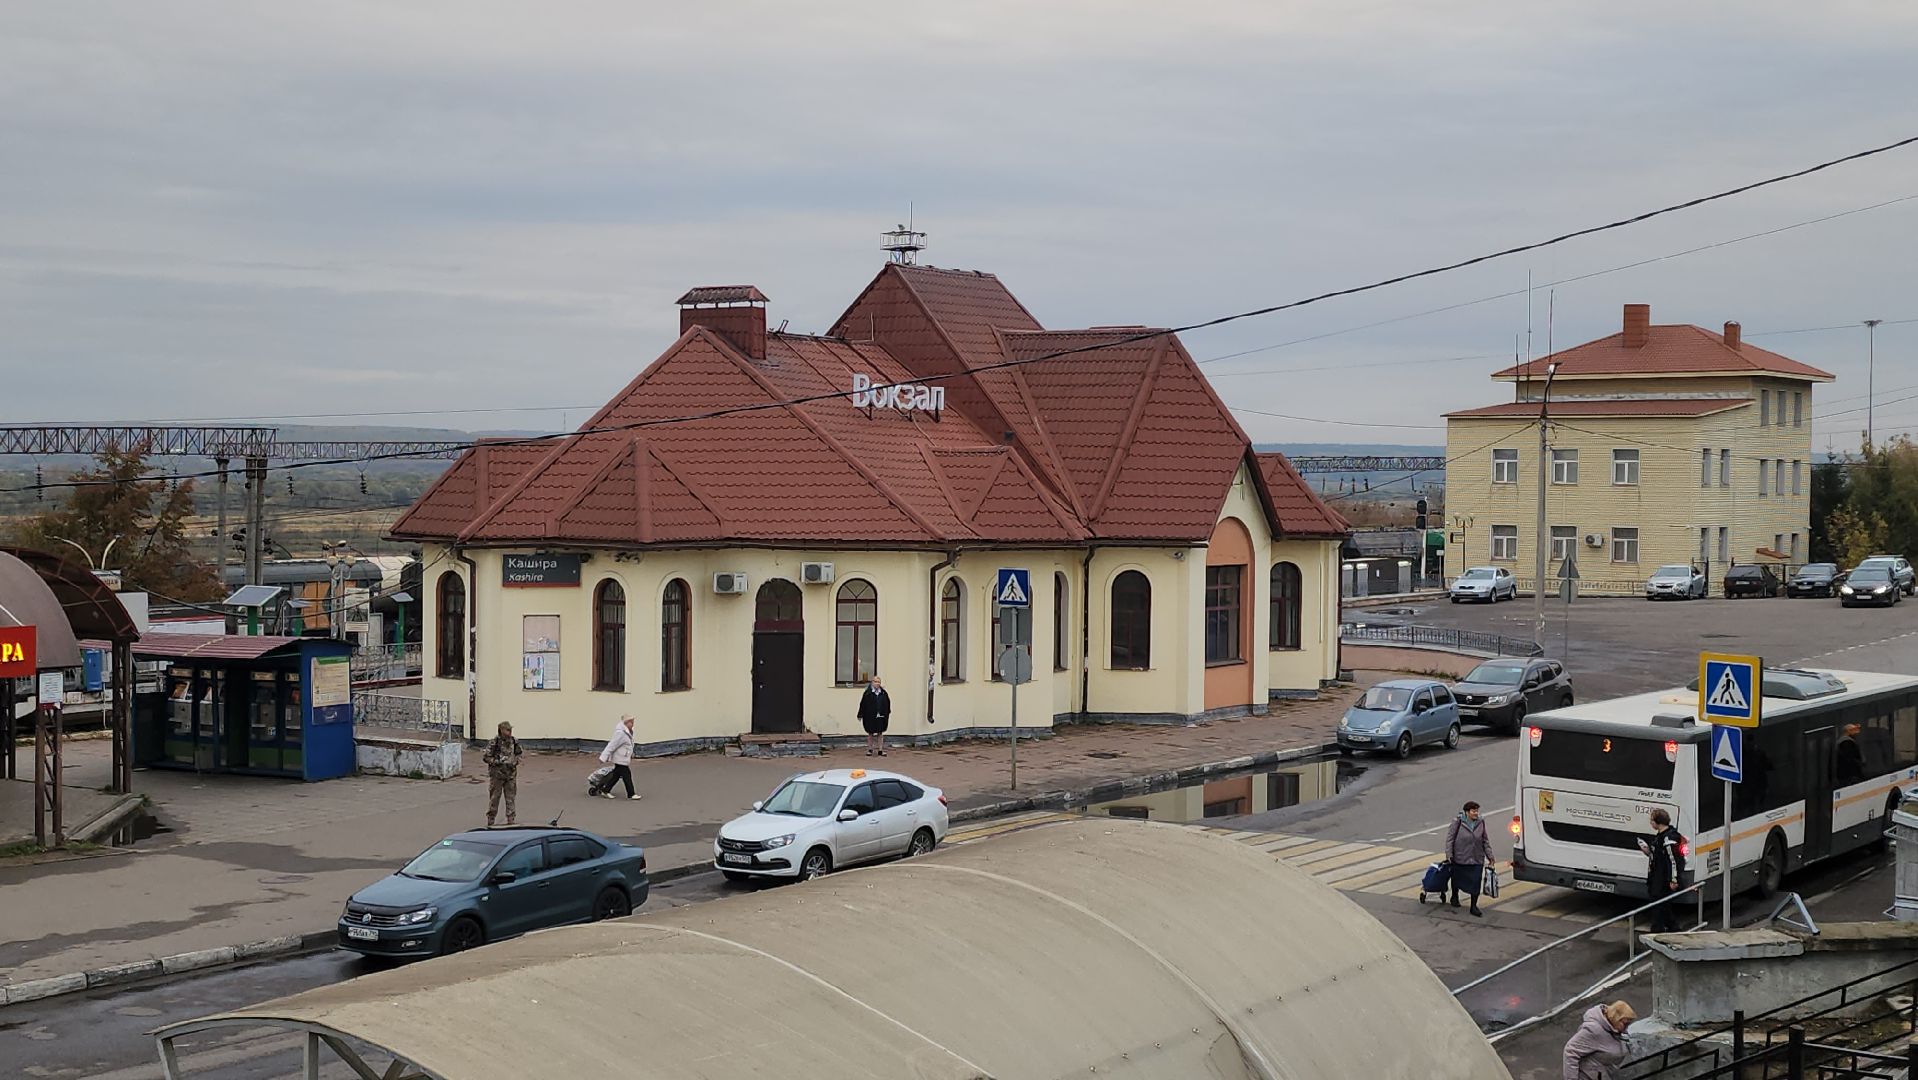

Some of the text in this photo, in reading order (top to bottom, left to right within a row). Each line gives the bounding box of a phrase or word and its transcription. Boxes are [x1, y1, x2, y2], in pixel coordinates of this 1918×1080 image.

[853, 374, 945, 411] Вокзал
[508, 558, 557, 571] Кашира
[509, 572, 544, 582] Kashira
[0, 642, 25, 663] РА
[1602, 738, 1612, 753] 3
